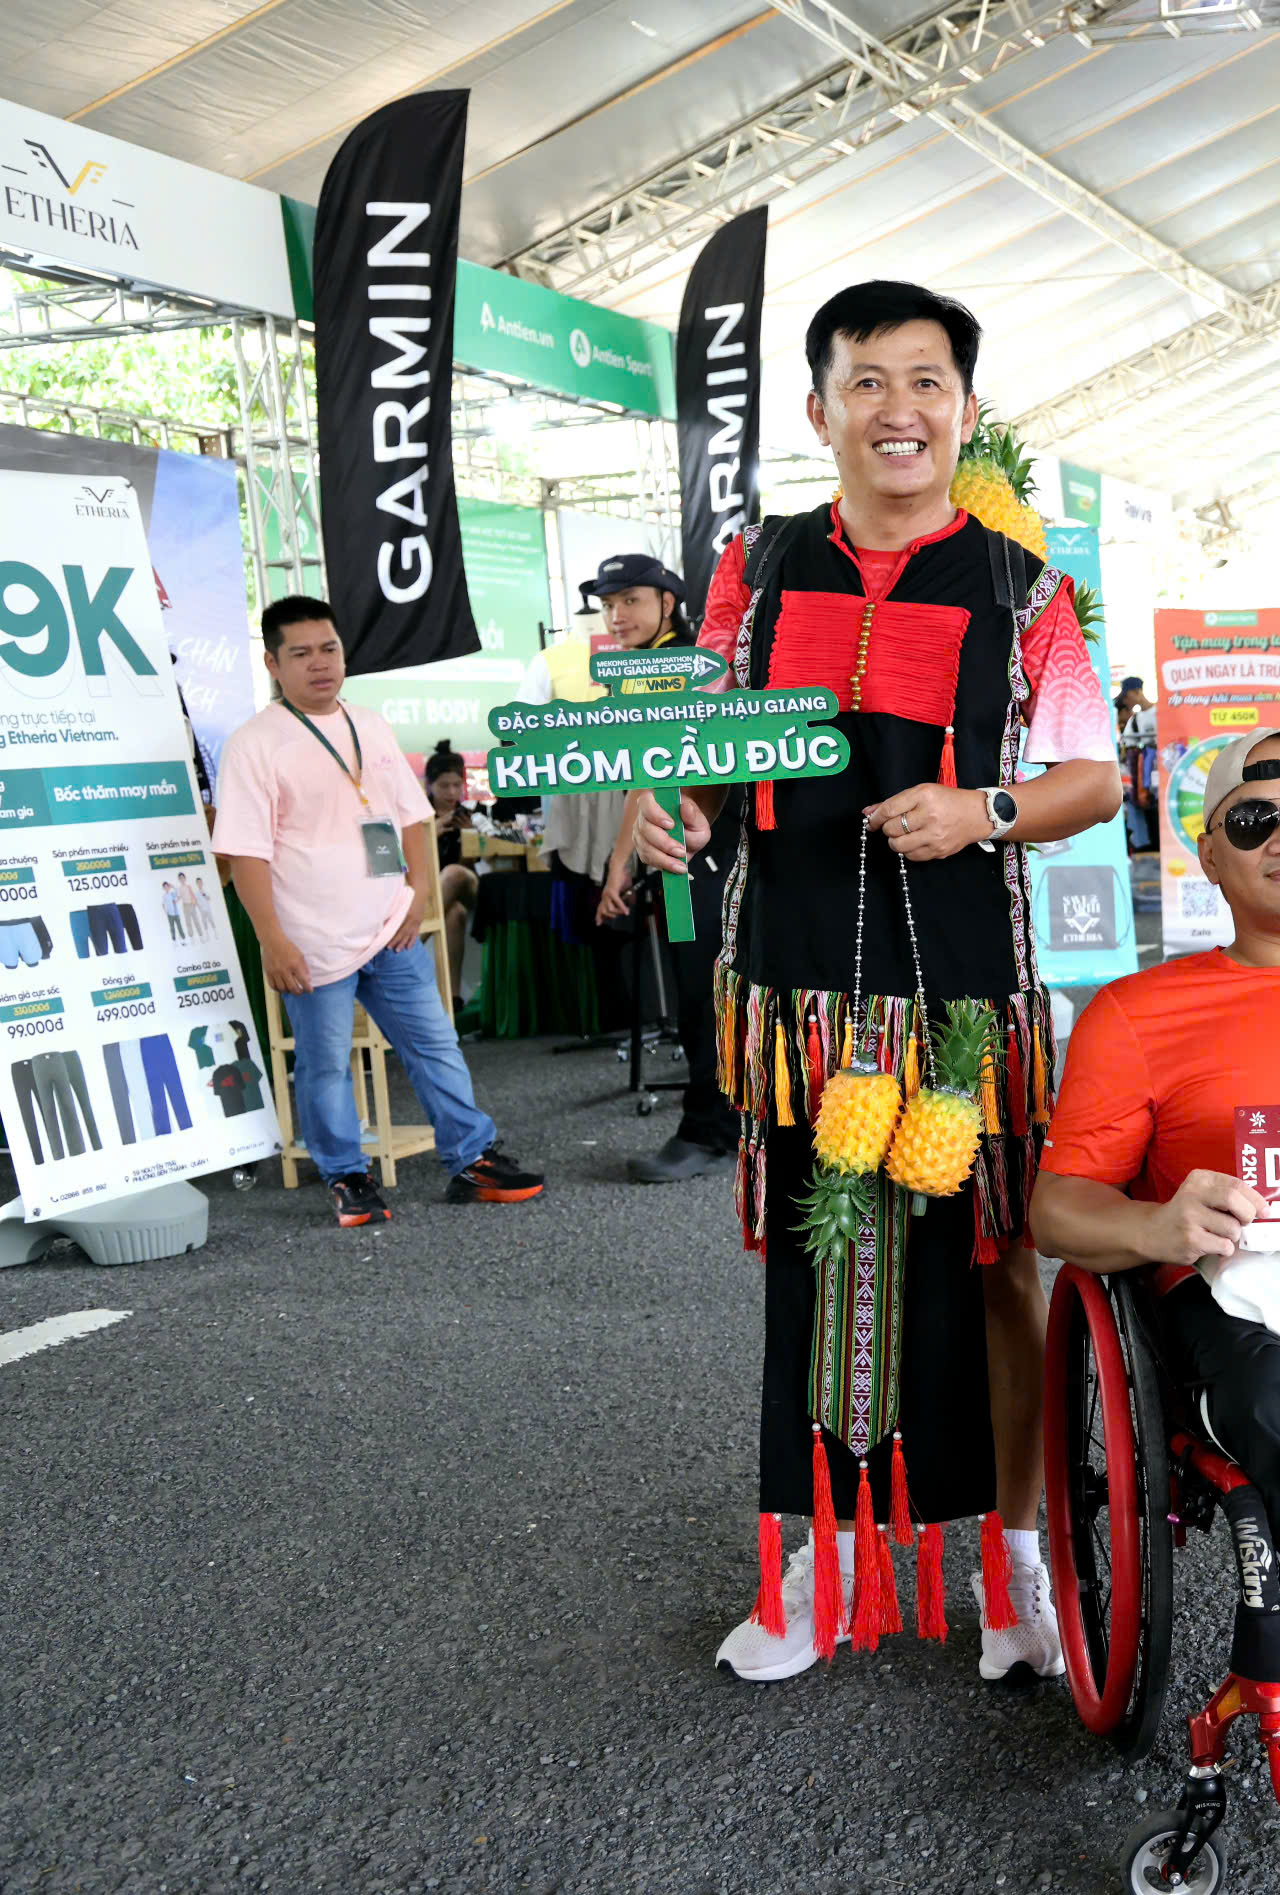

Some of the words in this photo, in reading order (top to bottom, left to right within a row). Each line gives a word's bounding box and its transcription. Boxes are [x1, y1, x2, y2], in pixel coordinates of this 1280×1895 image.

[4, 186, 139, 250] ETHERIA
[498, 315, 555, 348] Antien.vn
[592, 345, 625, 369] Antien
[365, 201, 433, 604] GARMIN
[75, 504, 130, 519] ETHERIA
[0, 560, 158, 677] 9K
[597, 667, 621, 677] HAU
[624, 665, 659, 675] GIANG
[661, 663, 692, 673] 2025
[628, 658, 651, 666] DELTA
[652, 655, 693, 664] MARATHON
[1171, 663, 1202, 684] QUAY
[1205, 662, 1238, 679] NGAY
[1240, 658, 1255, 678] LÀ
[645, 678, 682, 691] VNMS
[20, 711, 49, 728] trực
[382, 699, 420, 725] GET
[424, 698, 480, 724] BODY
[498, 712, 539, 734] ĐẶC
[544, 705, 582, 728] SẢN
[586, 705, 642, 726] NÔNG
[646, 701, 717, 724] NGHIỆP
[721, 697, 760, 719] HẬU
[764, 696, 827, 713] GIANG
[1231, 711, 1257, 721] 450K
[8, 729, 58, 745] Etheria
[58, 729, 119, 745] Vietnam.
[495, 740, 632, 789] KHÓM
[642, 724, 736, 779] CẦU
[745, 725, 840, 773] ĐÚC
[53, 784, 81, 802] Bốc
[82, 784, 119, 801] thăm
[120, 784, 149, 800] may
[17, 805, 35, 820] gia
[91, 847, 109, 855] mua
[68, 874, 128, 892] 125.000đ
[177, 987, 234, 1009] 250.000đ
[96, 1001, 156, 1023] 499.000đ
[7, 1017, 64, 1039] 99.000đ
[1234, 1517, 1268, 1608] Wisking
